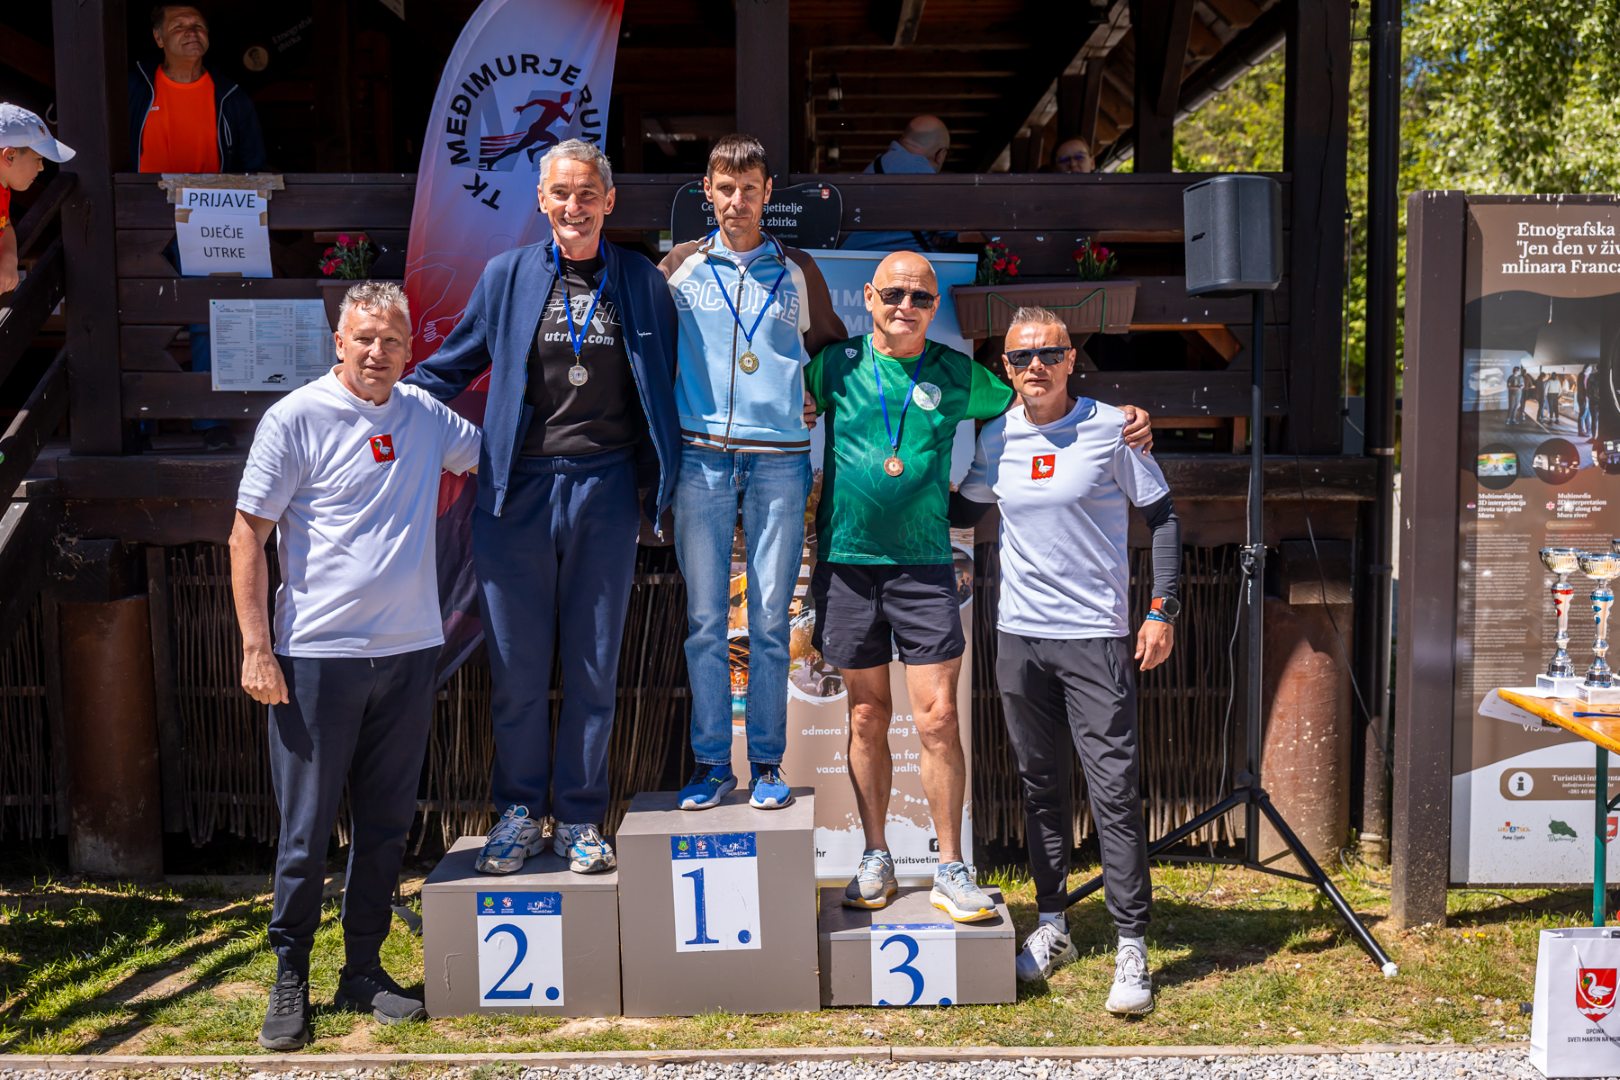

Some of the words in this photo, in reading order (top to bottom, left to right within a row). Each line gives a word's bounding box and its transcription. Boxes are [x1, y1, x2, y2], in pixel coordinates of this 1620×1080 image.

[446, 54, 581, 166] MEĐIMURJE
[462, 173, 502, 210] TK
[188, 192, 256, 208] PRIJAVE
[762, 202, 803, 213] sjetitelje
[767, 217, 797, 227] zbirka
[201, 225, 244, 239] DJEČJE
[1517, 221, 1616, 241] Etnografska
[204, 246, 246, 258] UTRKE
[1552, 240, 1584, 255] den
[1587, 245, 1597, 255] v
[1501, 259, 1567, 274] mlinara
[676, 279, 801, 327] SCORE
[801, 725, 842, 736] odmora
[834, 752, 841, 760] A
[904, 749, 919, 760] for
[681, 867, 752, 945] 1.
[484, 923, 560, 1001] 2.
[879, 934, 952, 1006] 3.
